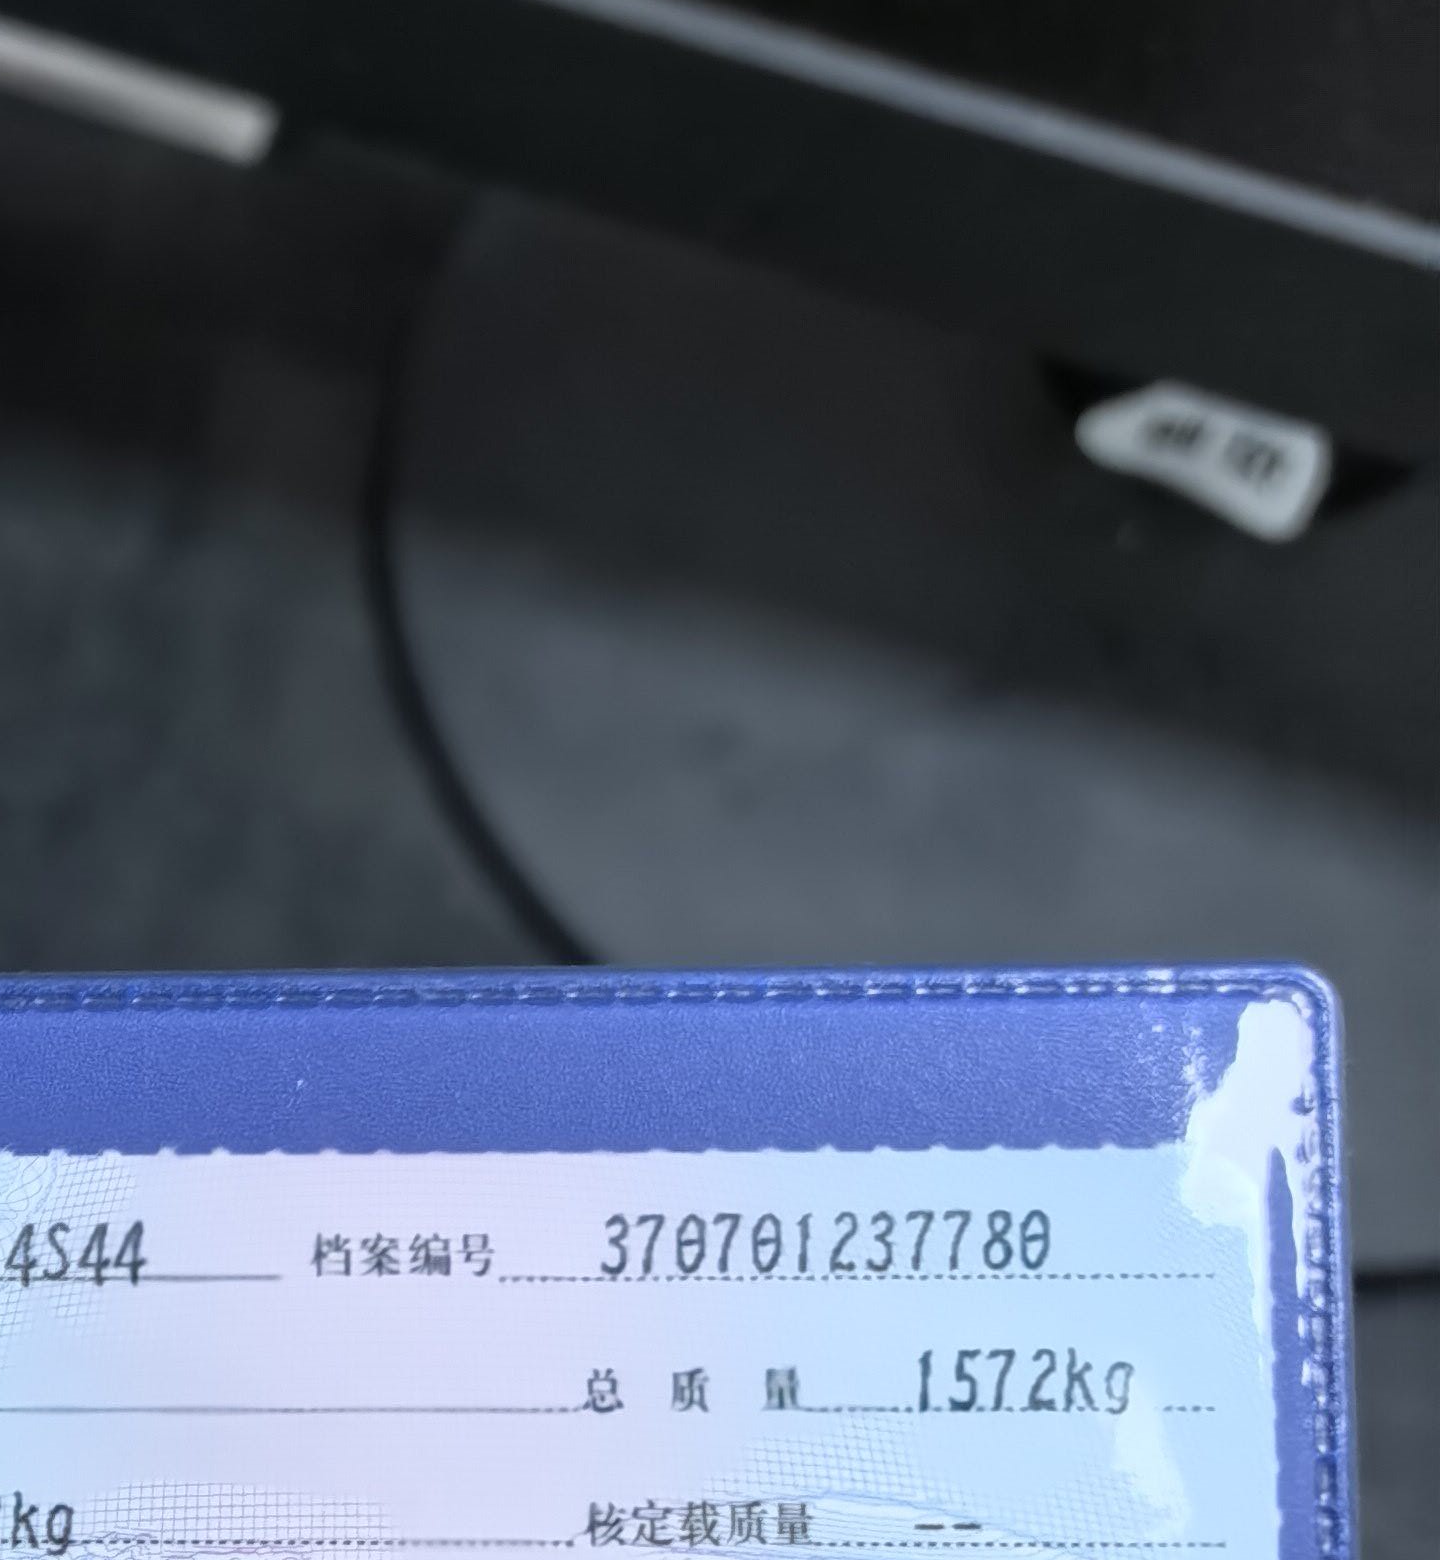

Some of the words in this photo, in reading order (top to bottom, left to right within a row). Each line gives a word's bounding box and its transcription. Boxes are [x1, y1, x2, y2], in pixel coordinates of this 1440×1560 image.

[311, 1234, 496, 1278] 档案编号
[599, 1209, 1052, 1277] 370701237780
[915, 1347, 1134, 1415] 1572kg
[584, 1501, 813, 1549] 核定载质量
